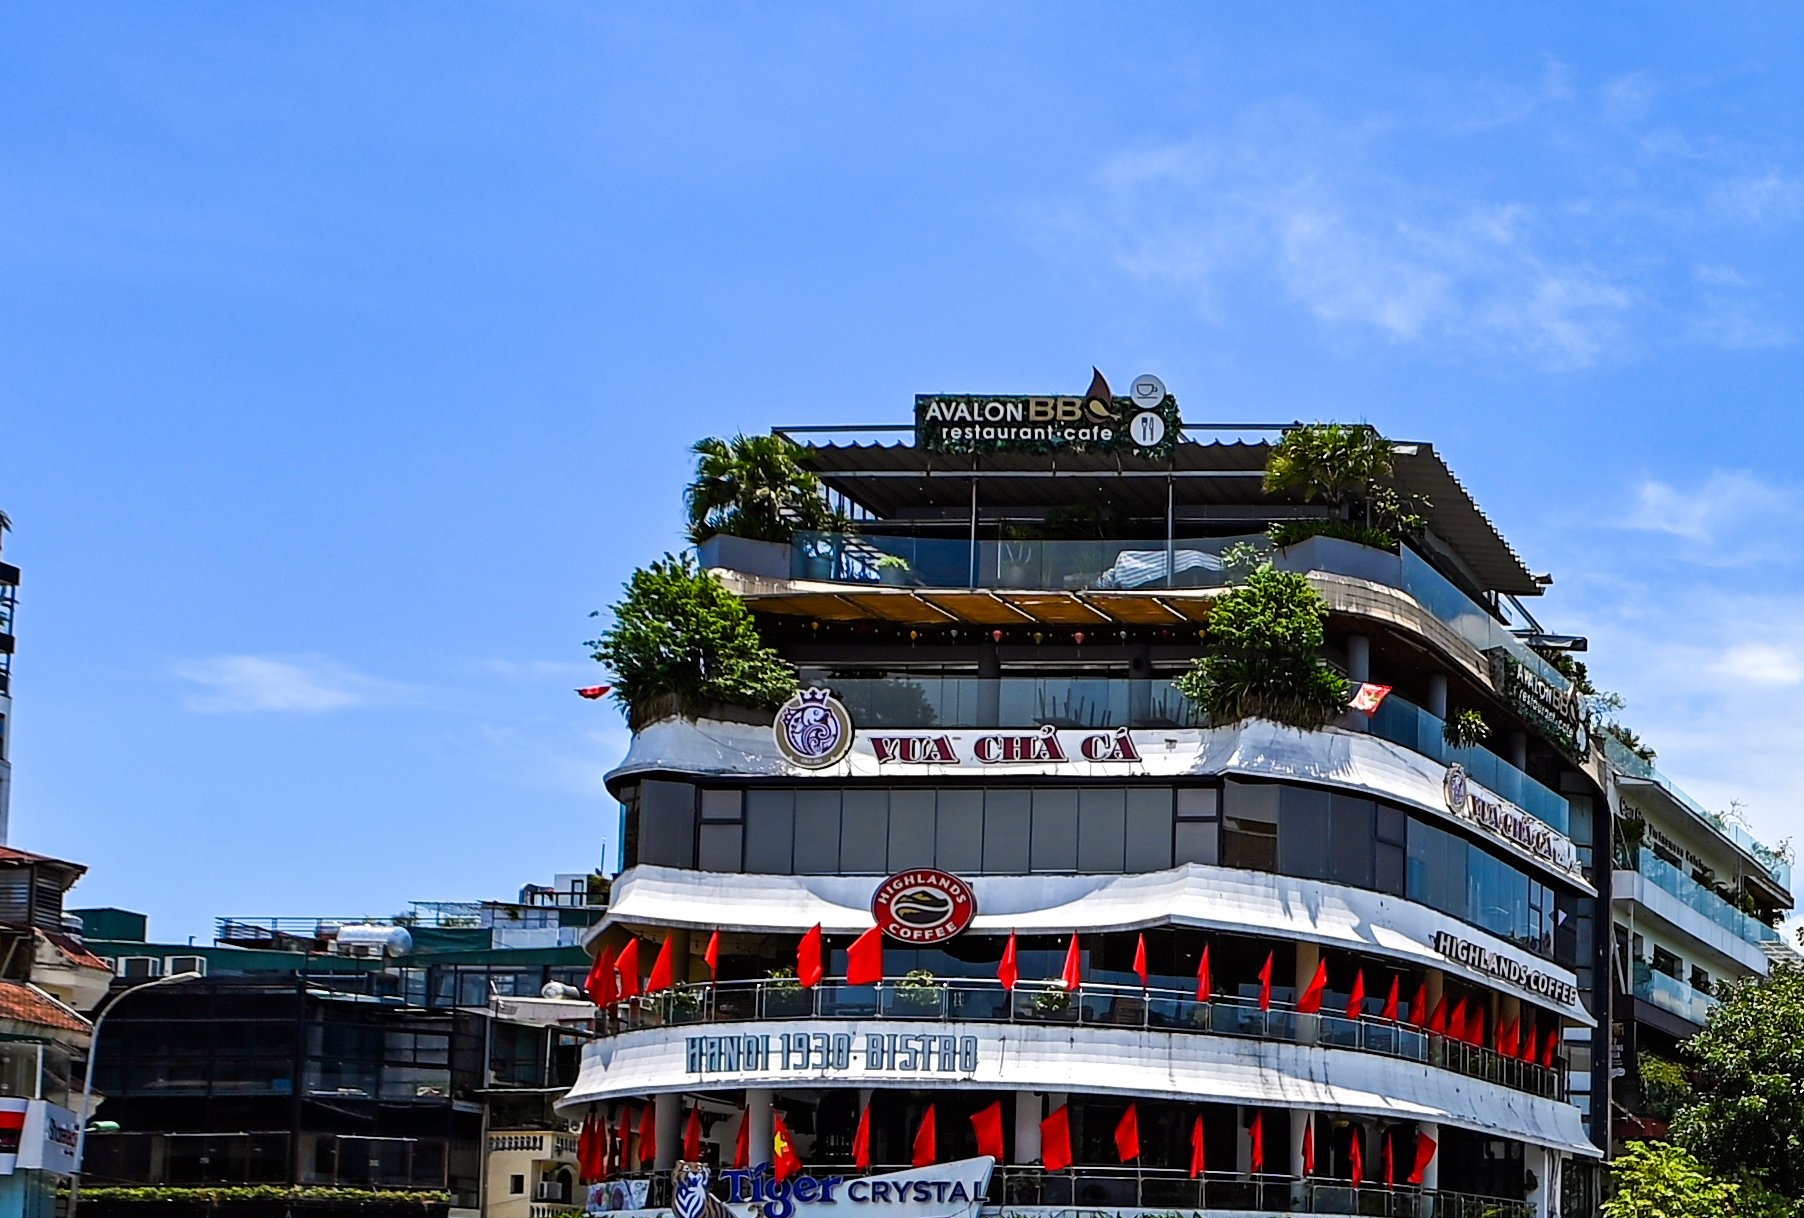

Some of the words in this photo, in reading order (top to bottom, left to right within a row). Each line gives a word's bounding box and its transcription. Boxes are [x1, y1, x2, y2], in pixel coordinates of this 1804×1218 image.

[925, 402, 1023, 422] AVALON
[868, 733, 959, 765] VUA
[973, 724, 1068, 765] CHẢ
[1080, 726, 1143, 765] CÁ
[877, 873, 967, 905] HIGHLANDS
[888, 921, 958, 940] COFFEE
[1438, 932, 1529, 986] HIGHLANDS
[1529, 969, 1578, 1005] COFFEE
[684, 1032, 770, 1073] HANOI
[779, 1032, 850, 1072] 1930
[864, 1033, 979, 1073] BISTRO
[847, 1180, 990, 1204] CRYSTAL
